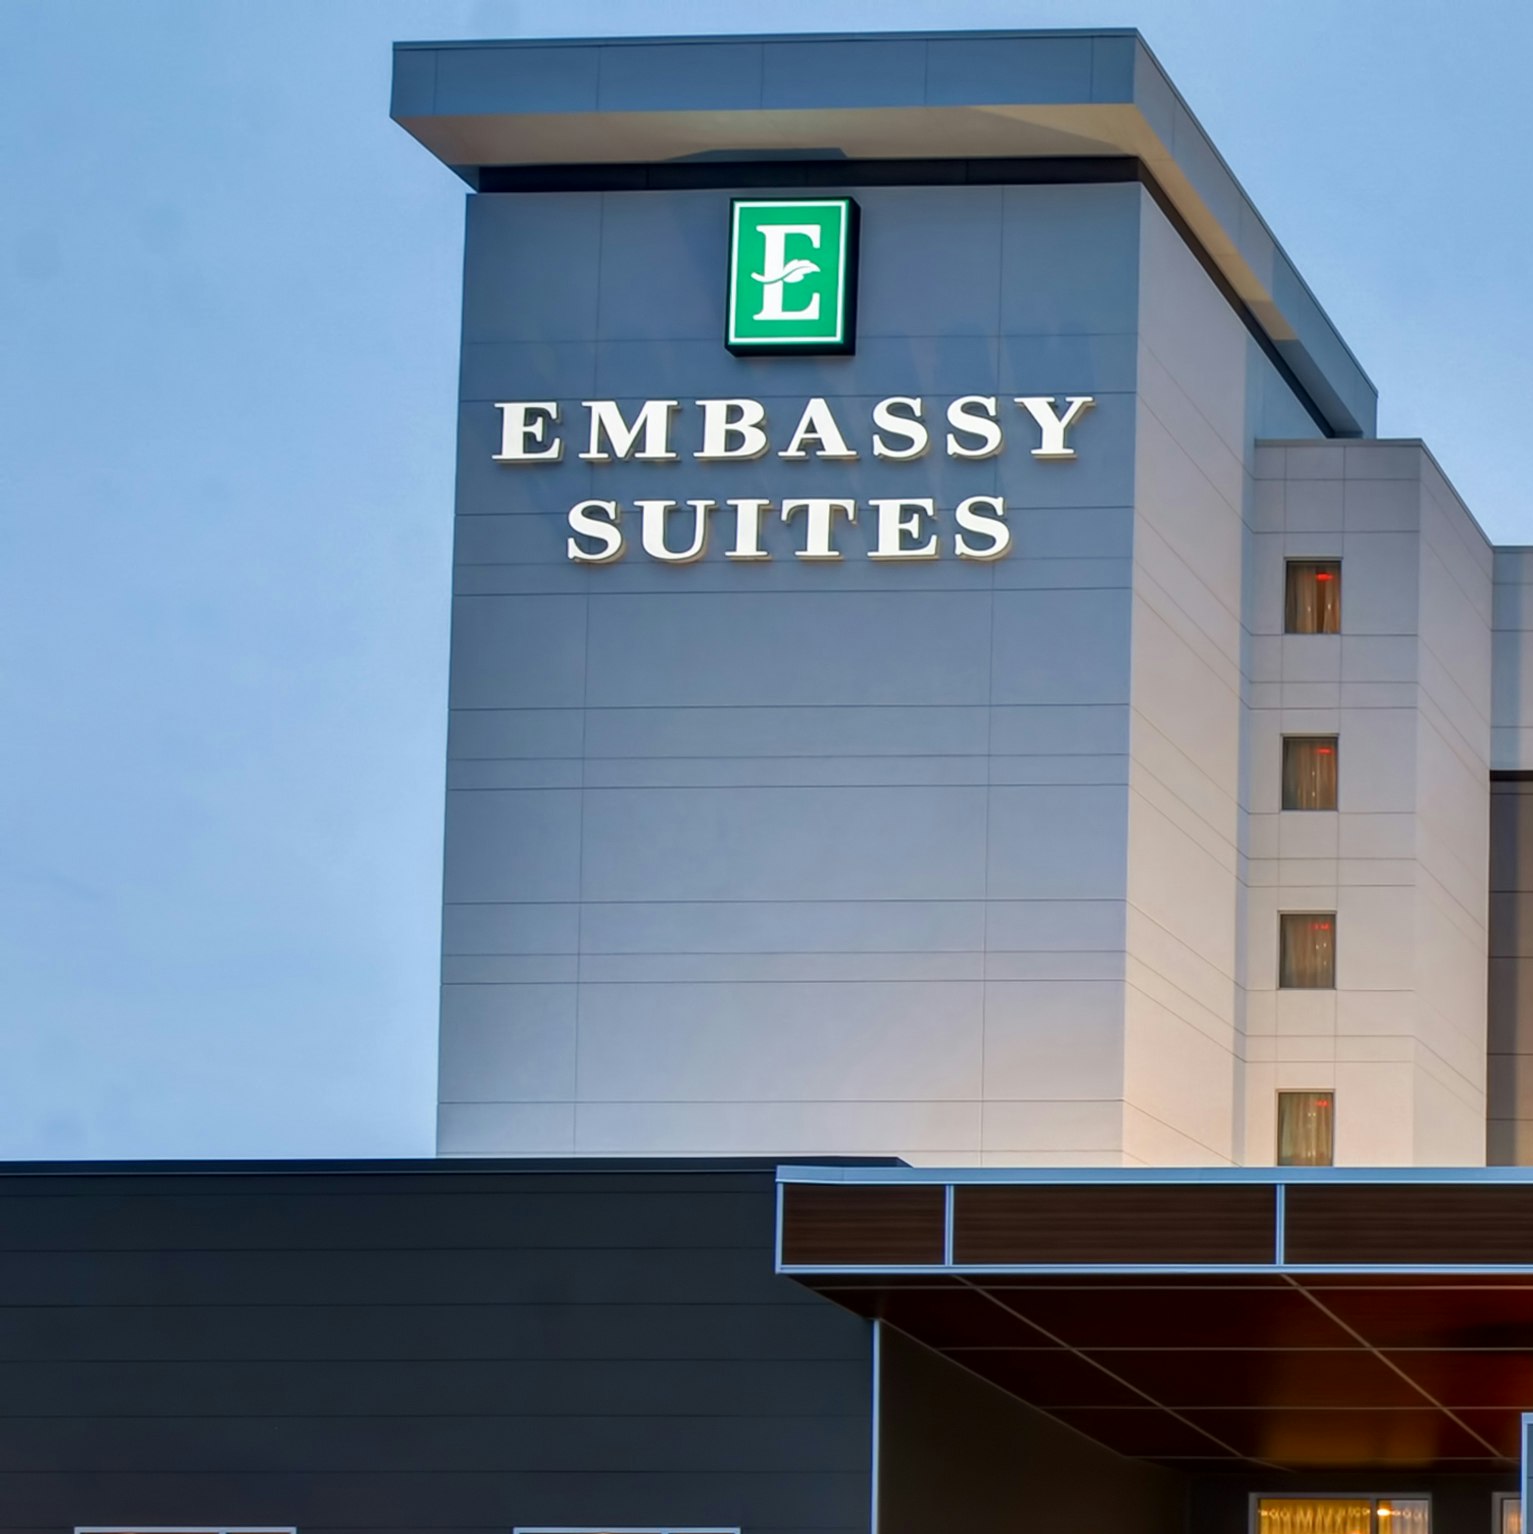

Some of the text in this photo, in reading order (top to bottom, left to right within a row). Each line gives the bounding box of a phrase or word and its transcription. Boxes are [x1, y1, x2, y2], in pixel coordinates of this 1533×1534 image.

[752, 224, 822, 321] E
[492, 396, 1094, 461] EMBASSY
[567, 496, 1012, 562] SUITES
